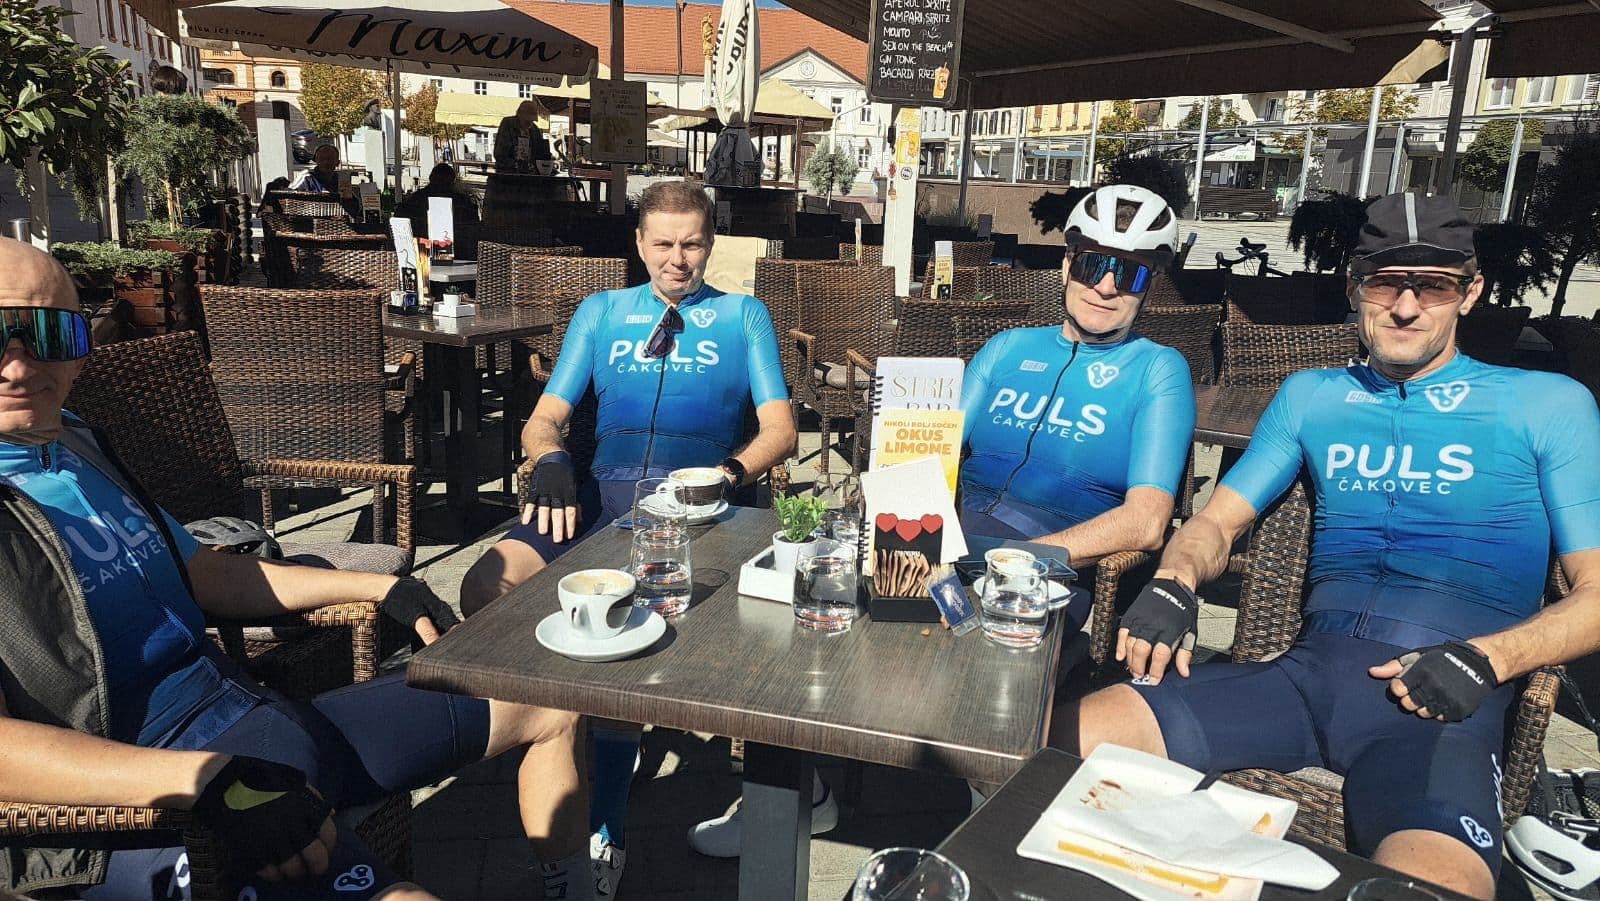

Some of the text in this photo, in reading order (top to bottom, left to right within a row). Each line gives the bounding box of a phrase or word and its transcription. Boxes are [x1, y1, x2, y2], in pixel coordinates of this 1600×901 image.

[882, 11, 951, 23] CAMPARI SPRITZ
[300, 9, 562, 62] Maxim
[883, 27, 911, 38] MOJITO
[897, 42, 910, 51] ON
[912, 43, 923, 51] THE
[925, 43, 947, 53] BEACH
[895, 55, 917, 65] TONIC
[617, 362, 706, 374] ČAKOVEC
[988, 388, 1107, 435] PULS
[896, 428, 944, 441] OKUS
[992, 413, 1086, 442] ČAKOVEC
[884, 441, 952, 456] LIMONE
[1326, 443, 1474, 482] PULS
[1338, 477, 1451, 495] ČAKOVEC
